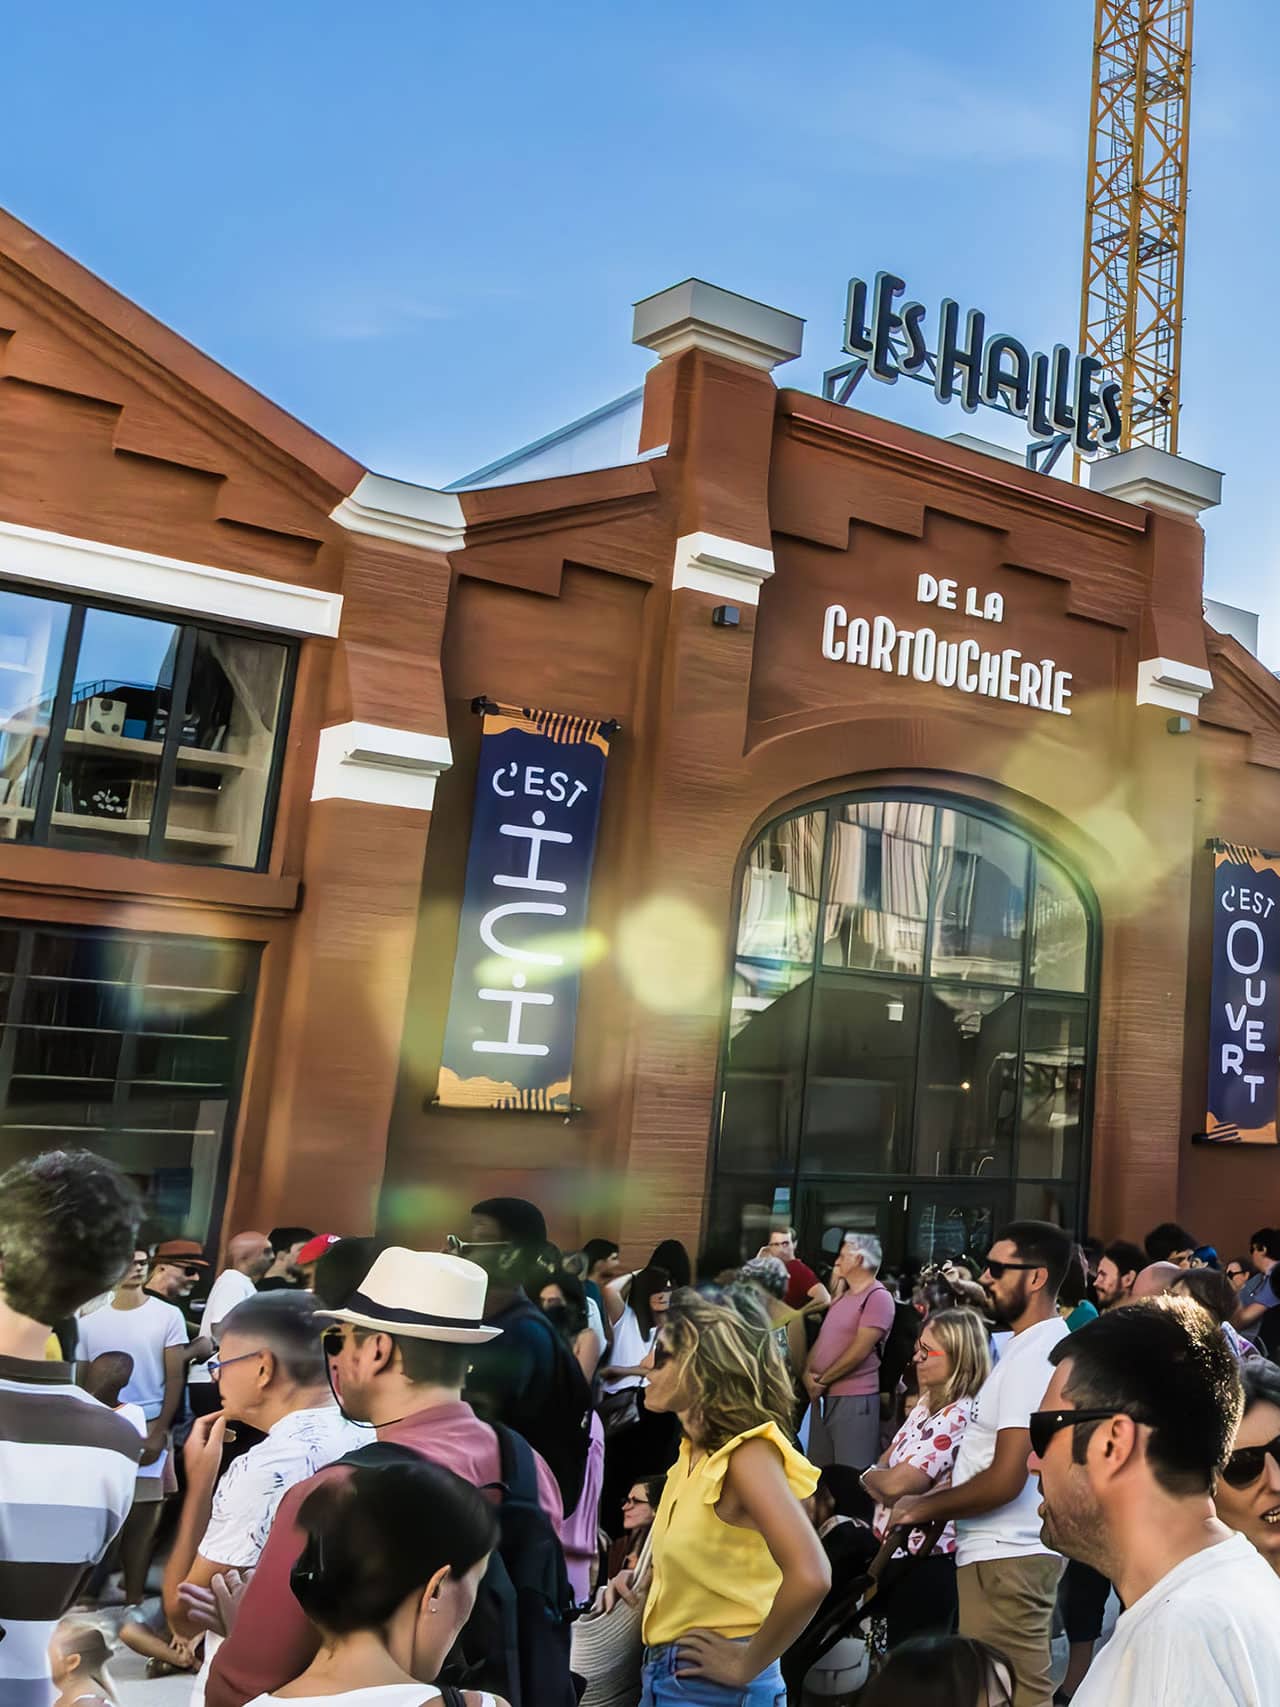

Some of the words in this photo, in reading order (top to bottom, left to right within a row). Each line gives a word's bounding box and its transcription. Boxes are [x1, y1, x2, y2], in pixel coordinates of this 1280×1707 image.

[845, 270, 926, 385] LES
[934, 297, 1122, 456] HALLES
[917, 572, 958, 610] DE
[965, 586, 1004, 622] LA
[821, 604, 1073, 715] CARTOUCHERIE
[492, 762, 589, 808] C'EST
[1221, 885, 1275, 919] C'EST
[1221, 919, 1267, 1104] OUVERT
